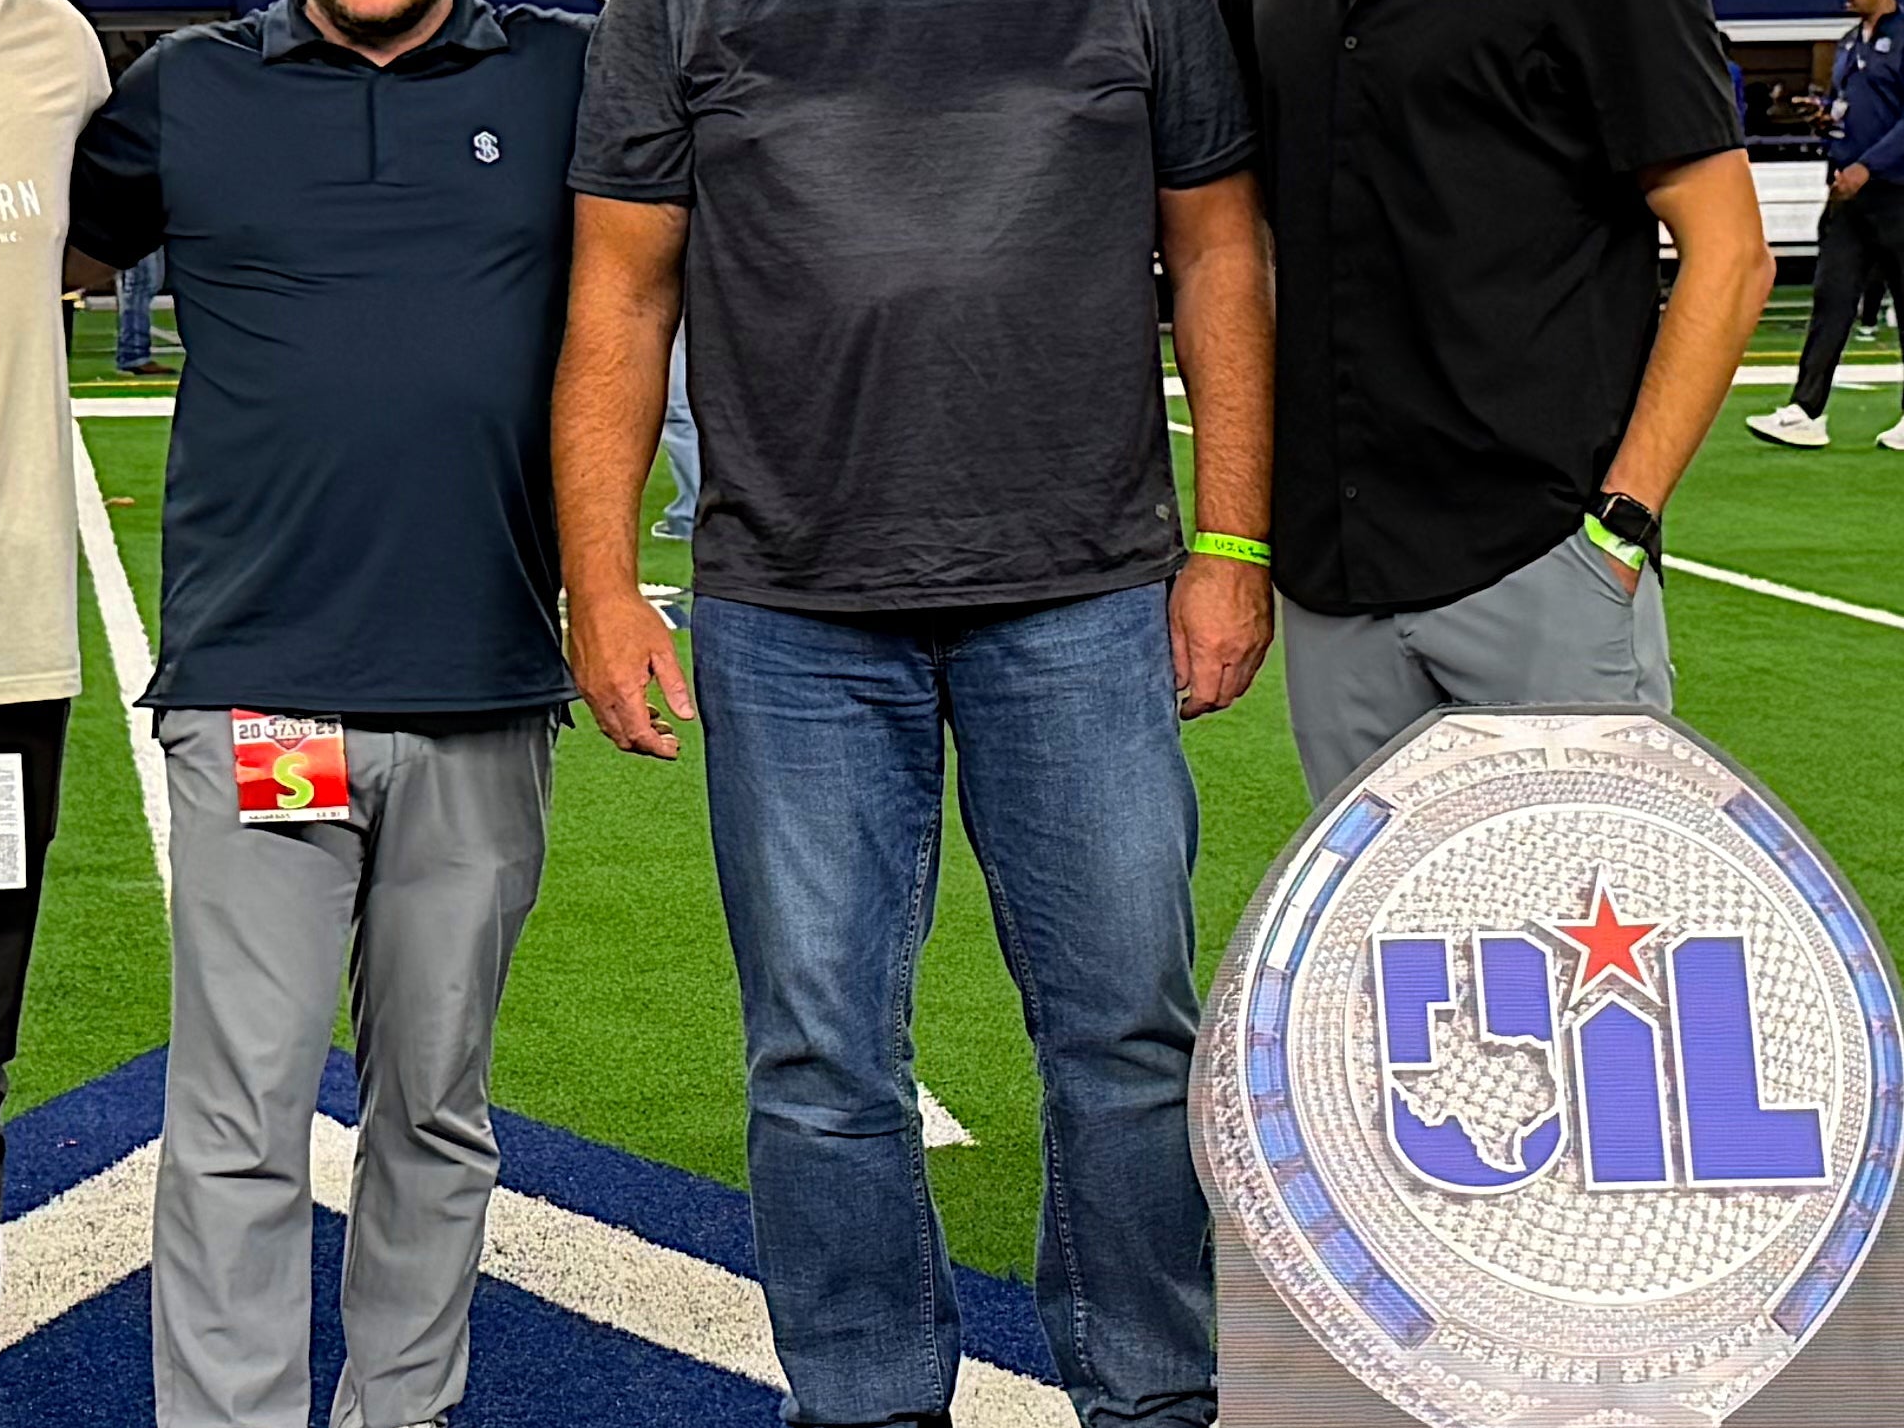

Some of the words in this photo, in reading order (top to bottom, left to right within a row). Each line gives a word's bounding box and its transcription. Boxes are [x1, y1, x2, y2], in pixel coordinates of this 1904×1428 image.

[238, 723, 262, 740] 20
[272, 751, 315, 809] S
[1371, 869, 1833, 1196] UIL
